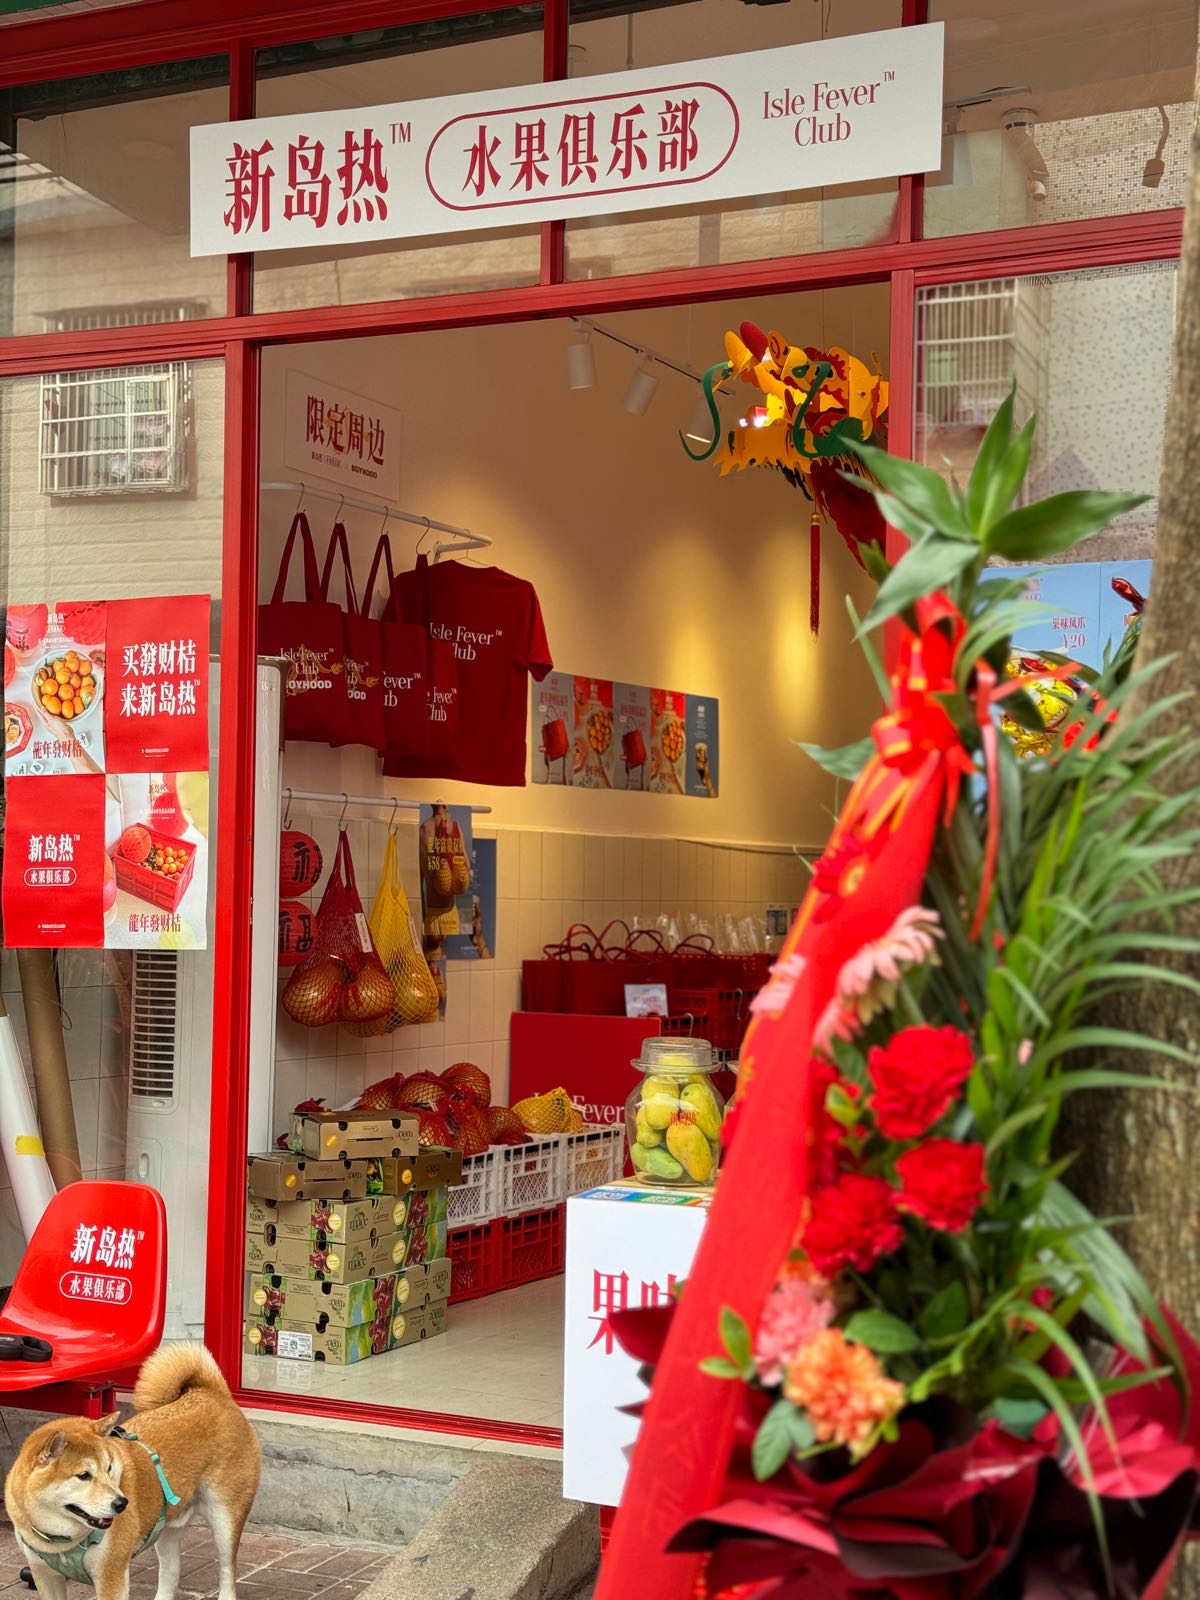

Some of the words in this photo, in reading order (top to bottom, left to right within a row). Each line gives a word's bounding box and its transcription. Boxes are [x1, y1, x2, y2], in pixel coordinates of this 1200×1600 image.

[762, 87, 806, 120] Isle
[812, 81, 881, 113] Fever
[794, 112, 852, 147] Club
[461, 97, 701, 198] 水果俱乐部
[223, 128, 389, 235] 新岛热
[306, 394, 385, 466] 限定周边
[456, 625, 495, 645] Fever
[452, 642, 477, 661] lub
[285, 679, 333, 690] OYHOOD
[383, 672, 414, 690] ever
[119, 680, 197, 718] 来新岛热
[28, 833, 74, 863] 新岛热
[30, 869, 71, 884] 水果俱乐部
[70, 1223, 135, 1270] 新岛热
[68, 1274, 125, 1301] 水果俱乐部
